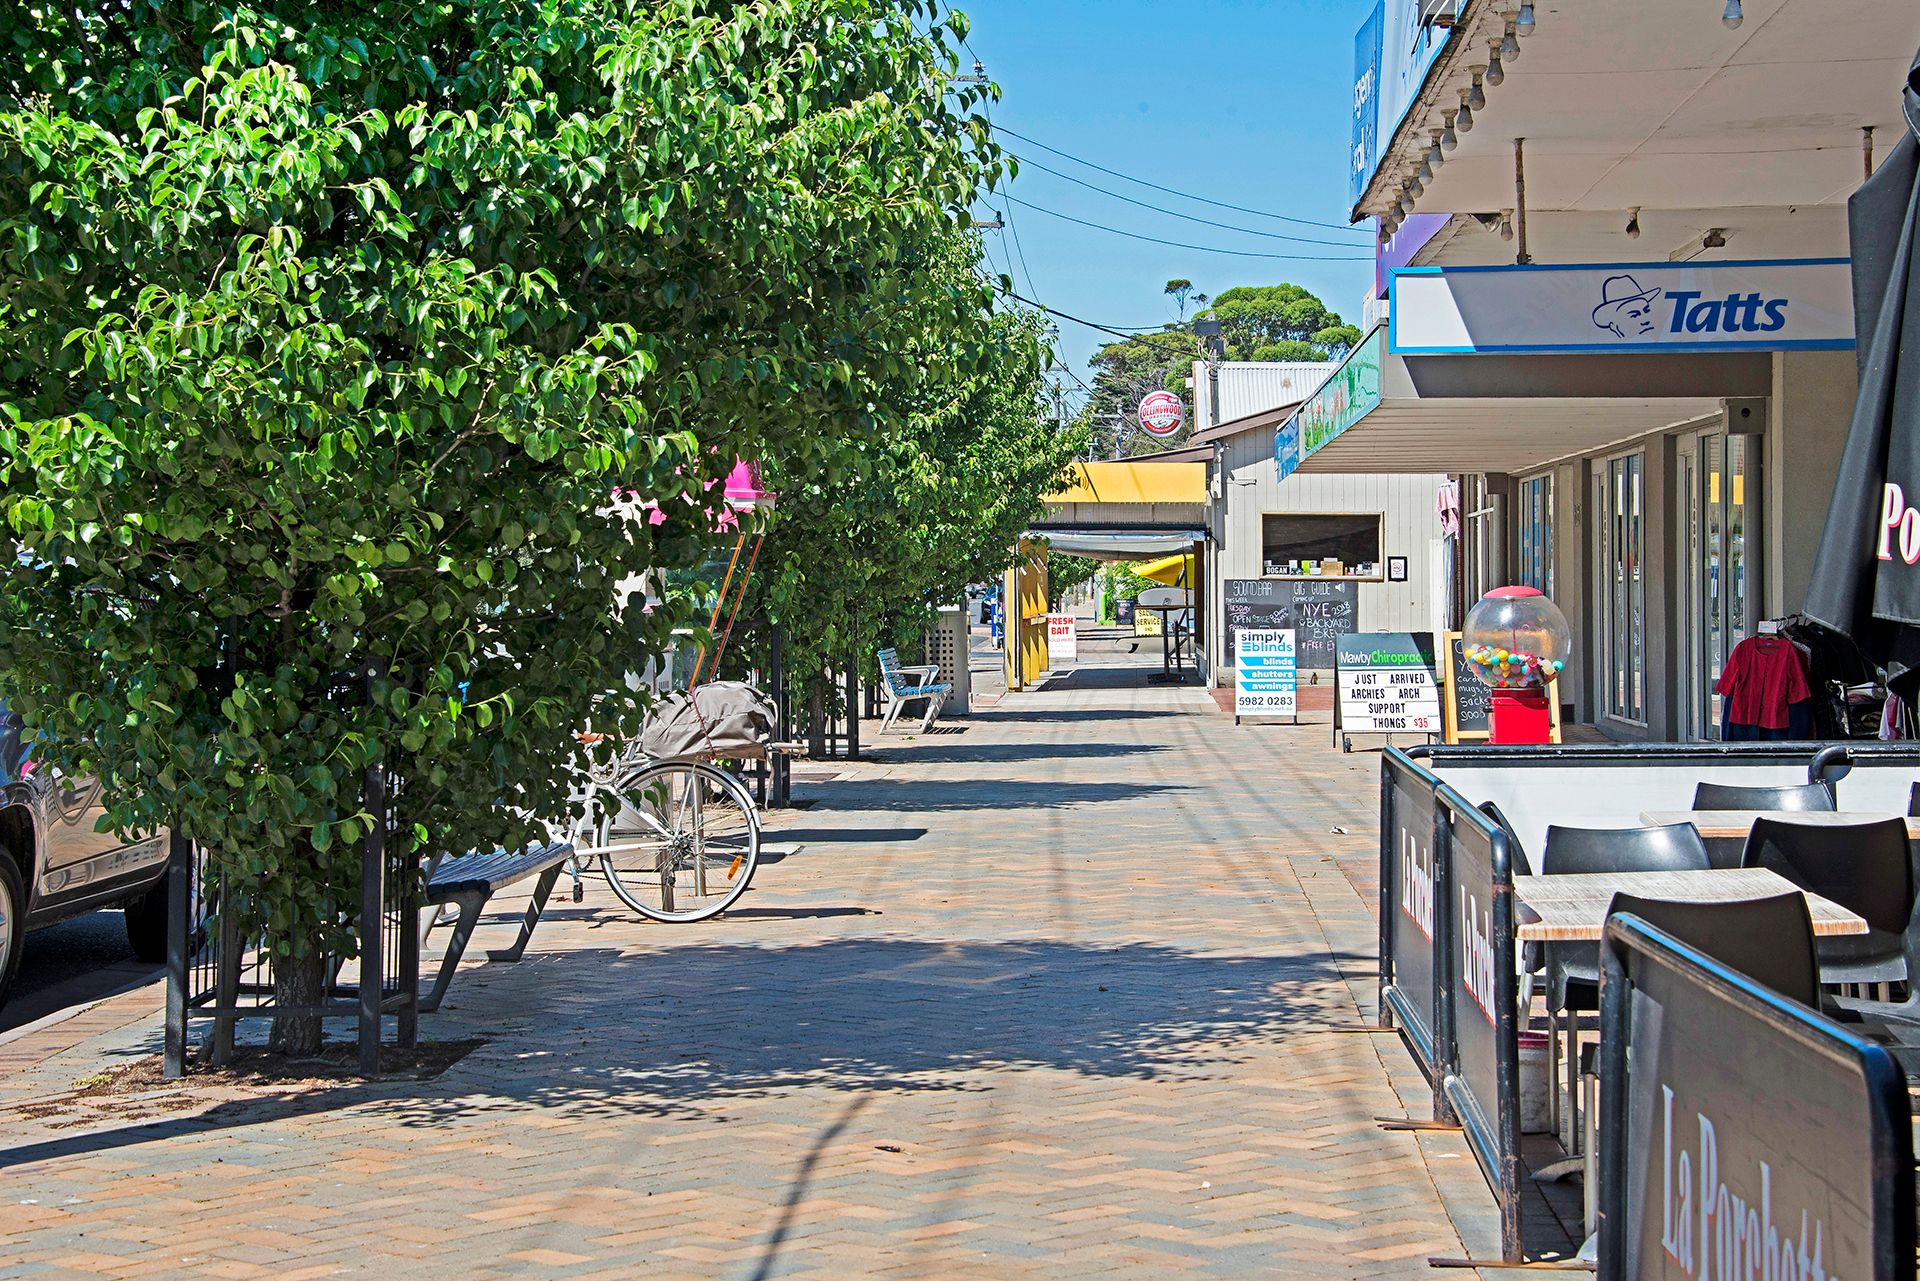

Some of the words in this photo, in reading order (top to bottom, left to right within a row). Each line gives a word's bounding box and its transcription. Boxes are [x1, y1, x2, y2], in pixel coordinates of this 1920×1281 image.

[1664, 291, 1788, 333] Tatts
[1140, 404, 1182, 420] COLLINGWOOD
[1266, 566, 1288, 574] BOGAN
[1312, 581, 1331, 595] GUIDE
[1303, 602, 1331, 617] NYE
[1332, 601, 1352, 616] 2018
[1047, 617, 1074, 625] FRESH
[1233, 615, 1251, 623] OPEN
[1306, 618, 1352, 629] BACKYARD
[1051, 627, 1070, 635] BAIT
[1241, 631, 1285, 644] simply
[1252, 642, 1293, 652] blinds
[1263, 657, 1294, 665] blinds
[1251, 670, 1294, 678] shutters
[1354, 674, 1377, 685] JUST
[1390, 673, 1425, 684] ARRIVED
[1251, 682, 1294, 691] awnings
[1351, 688, 1385, 699] ARCHIES
[1398, 688, 1420, 699] ARCH
[1239, 696, 1264, 706] 5982
[1267, 696, 1293, 706] 0283
[1368, 703, 1406, 714] SUPPORT
[1373, 718, 1406, 729] THONGS
[1413, 717, 1429, 728] $35
[1402, 827, 1411, 914] La
[1461, 885, 1473, 996] La
[1662, 1083, 1693, 1281] La
